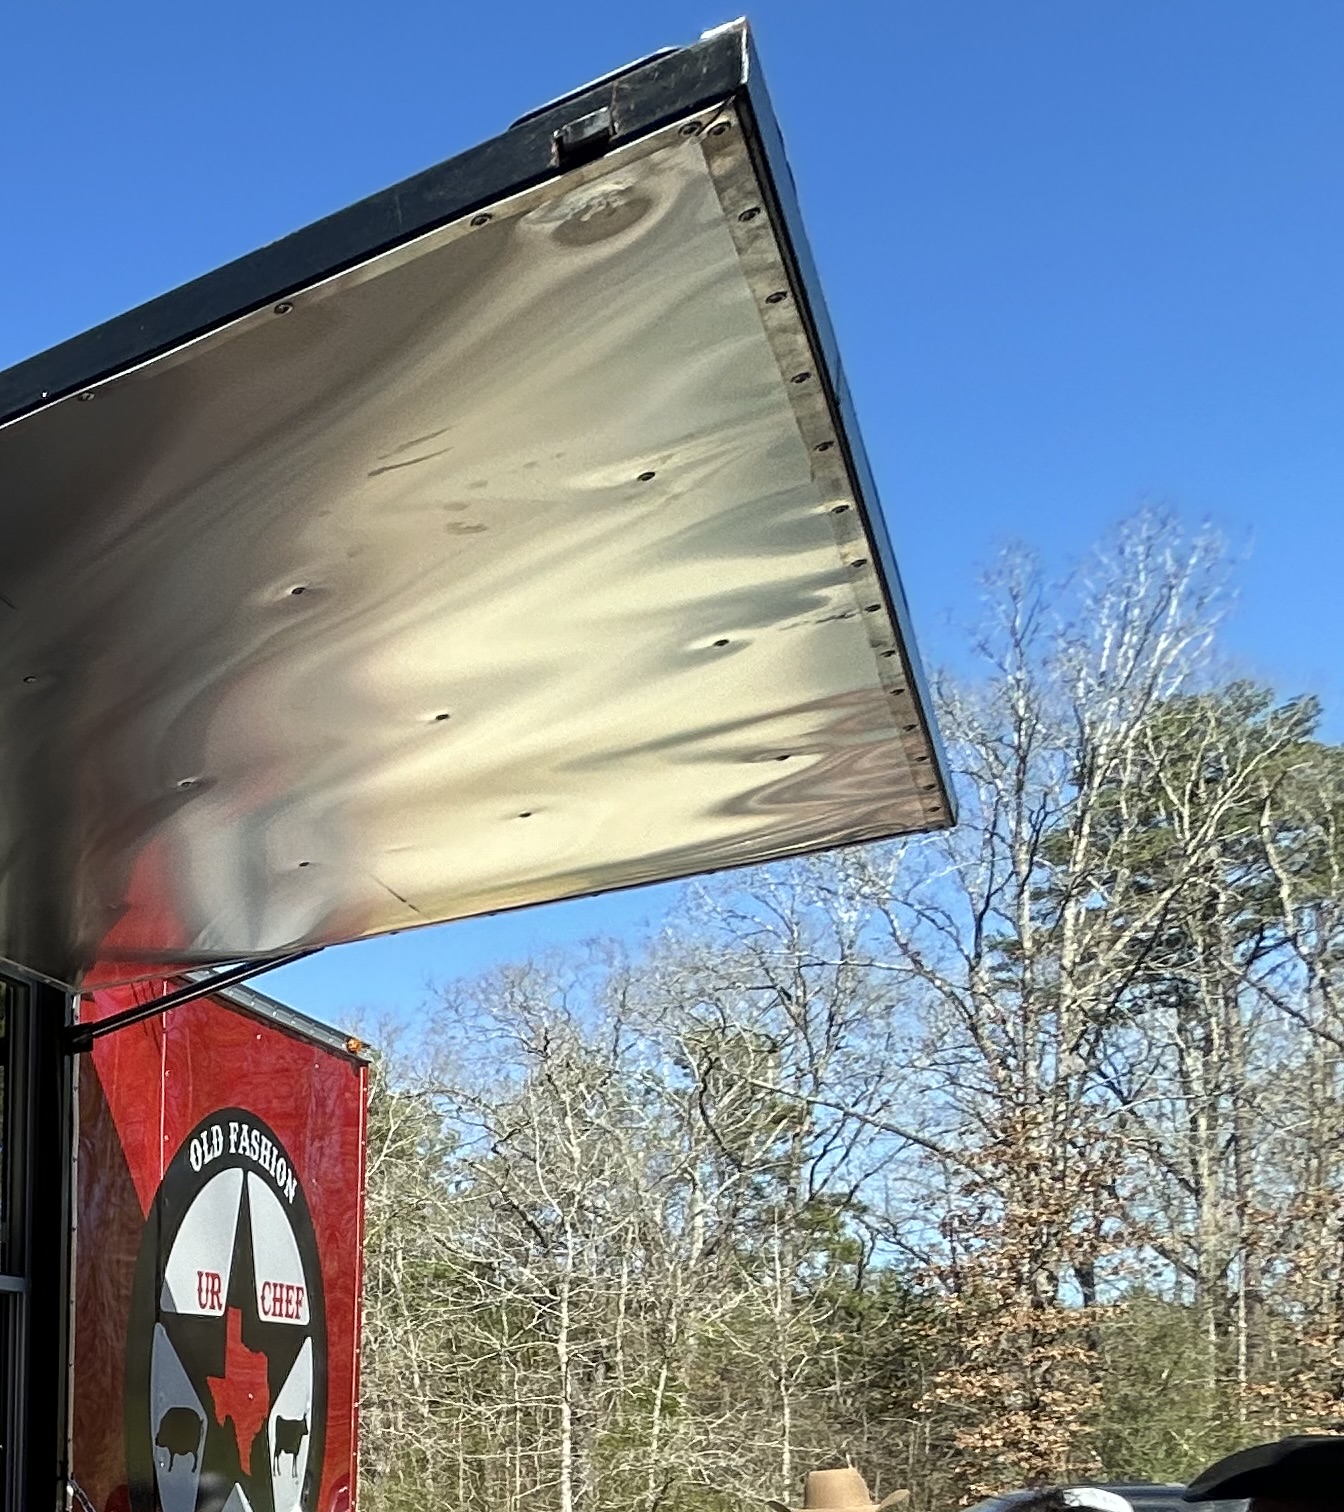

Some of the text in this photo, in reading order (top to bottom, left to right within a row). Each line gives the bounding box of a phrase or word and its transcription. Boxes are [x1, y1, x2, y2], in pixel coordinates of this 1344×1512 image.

[190, 1122, 298, 1204] OLD FASHION
[197, 1271, 305, 1320] UR CHEF
